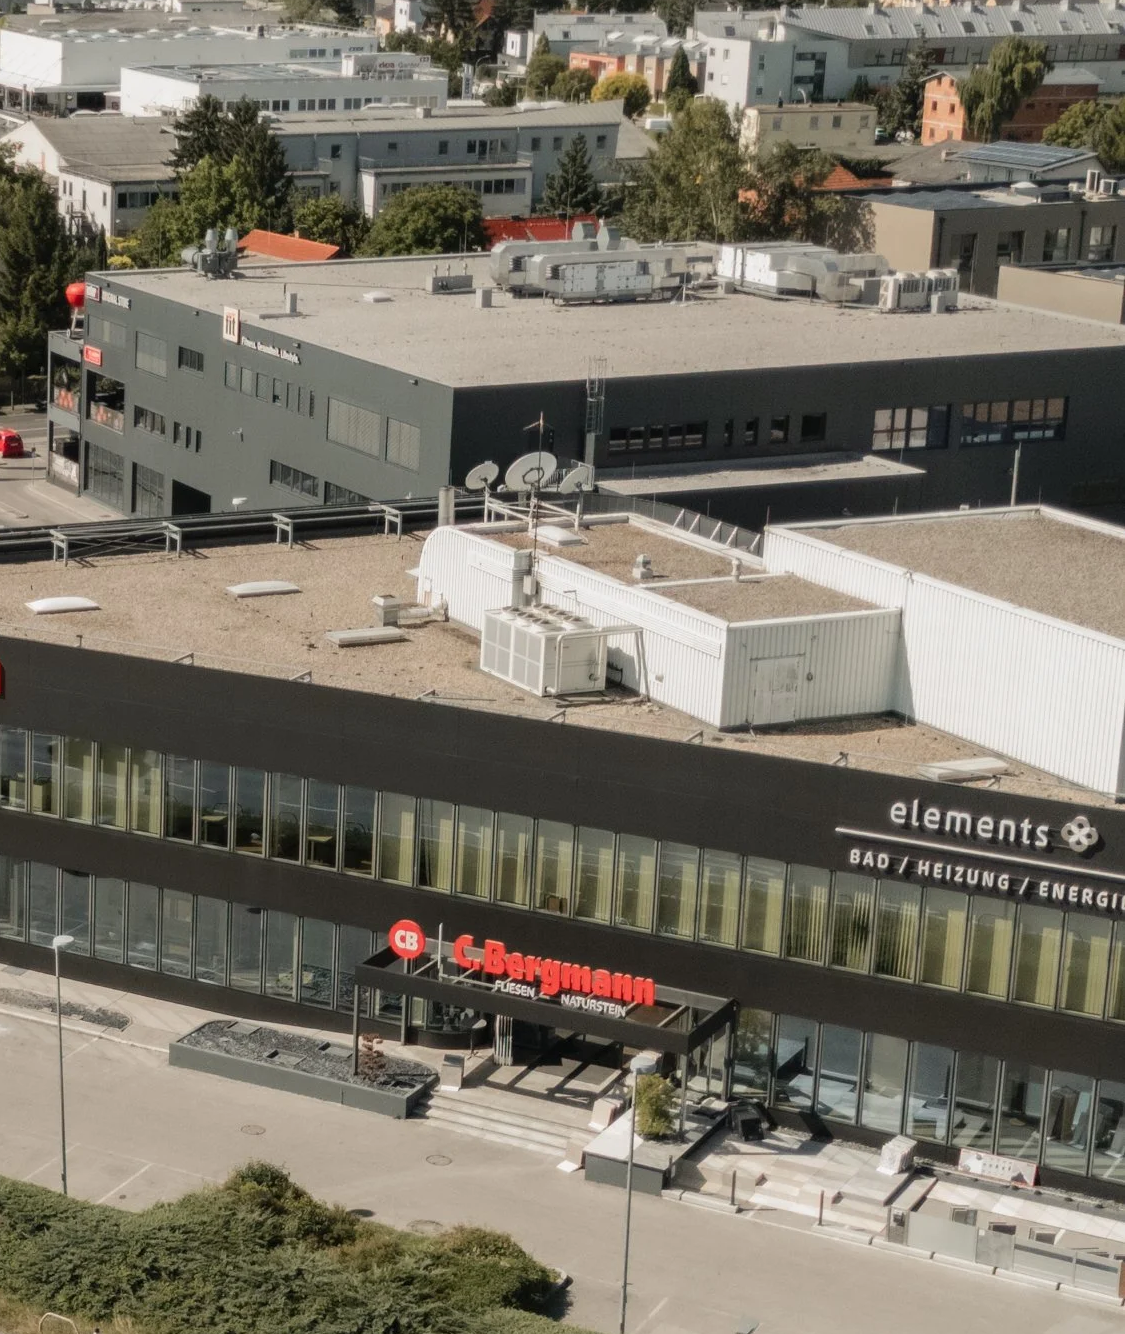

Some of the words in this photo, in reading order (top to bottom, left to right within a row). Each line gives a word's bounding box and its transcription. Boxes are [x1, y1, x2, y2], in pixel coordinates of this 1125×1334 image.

[890, 799, 1050, 847] elements
[850, 849, 889, 869] BAD
[918, 860, 1010, 890] HEIZUNG
[394, 929, 418, 951] CB
[453, 934, 655, 1007] C.Bergmann
[494, 979, 536, 998] FLIESEN
[560, 994, 626, 1017] NATURSTEIN
